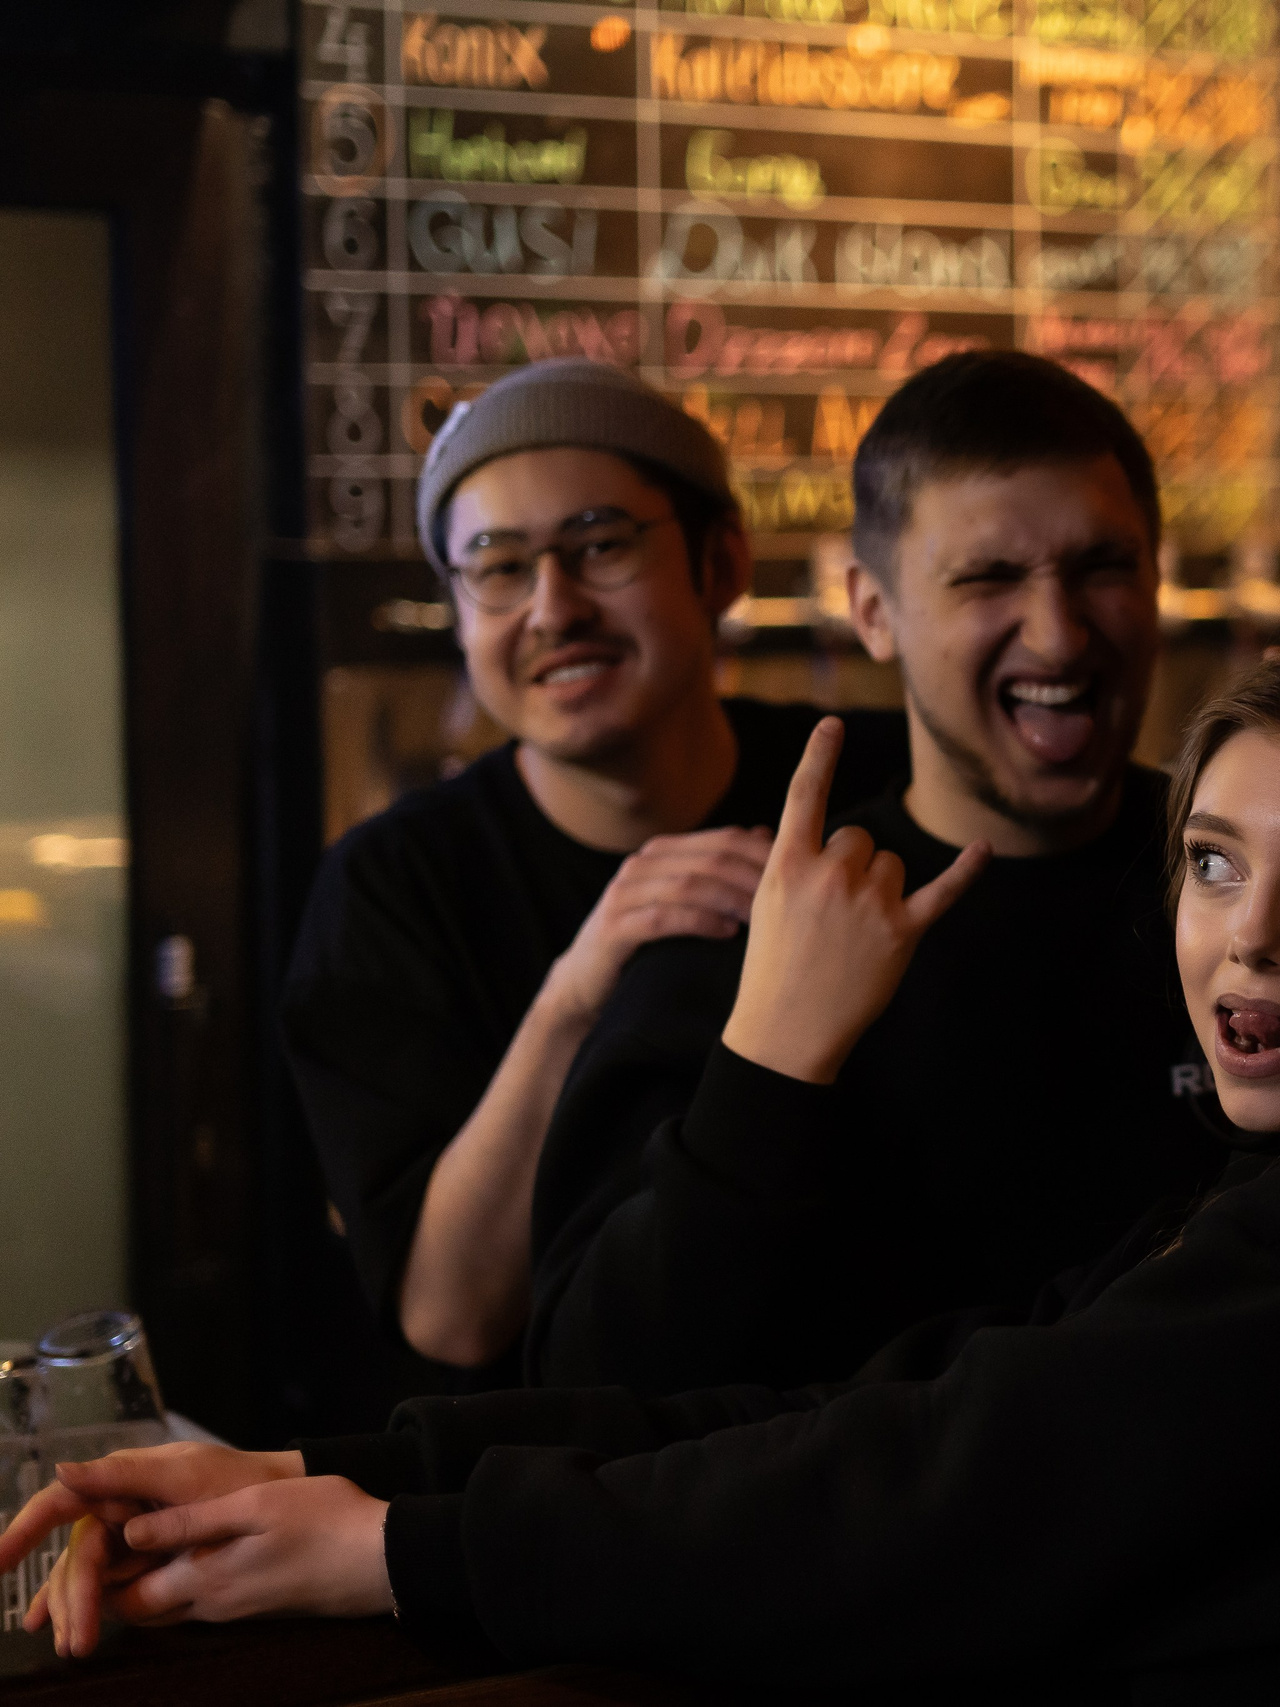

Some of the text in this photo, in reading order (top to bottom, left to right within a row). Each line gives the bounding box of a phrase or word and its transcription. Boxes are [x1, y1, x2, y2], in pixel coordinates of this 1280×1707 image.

[316, 3, 368, 84] 4
[322, 198, 378, 273] 6
[322, 288, 378, 370] 7
[326, 368, 382, 456] 8
[328, 458, 384, 551] 9
